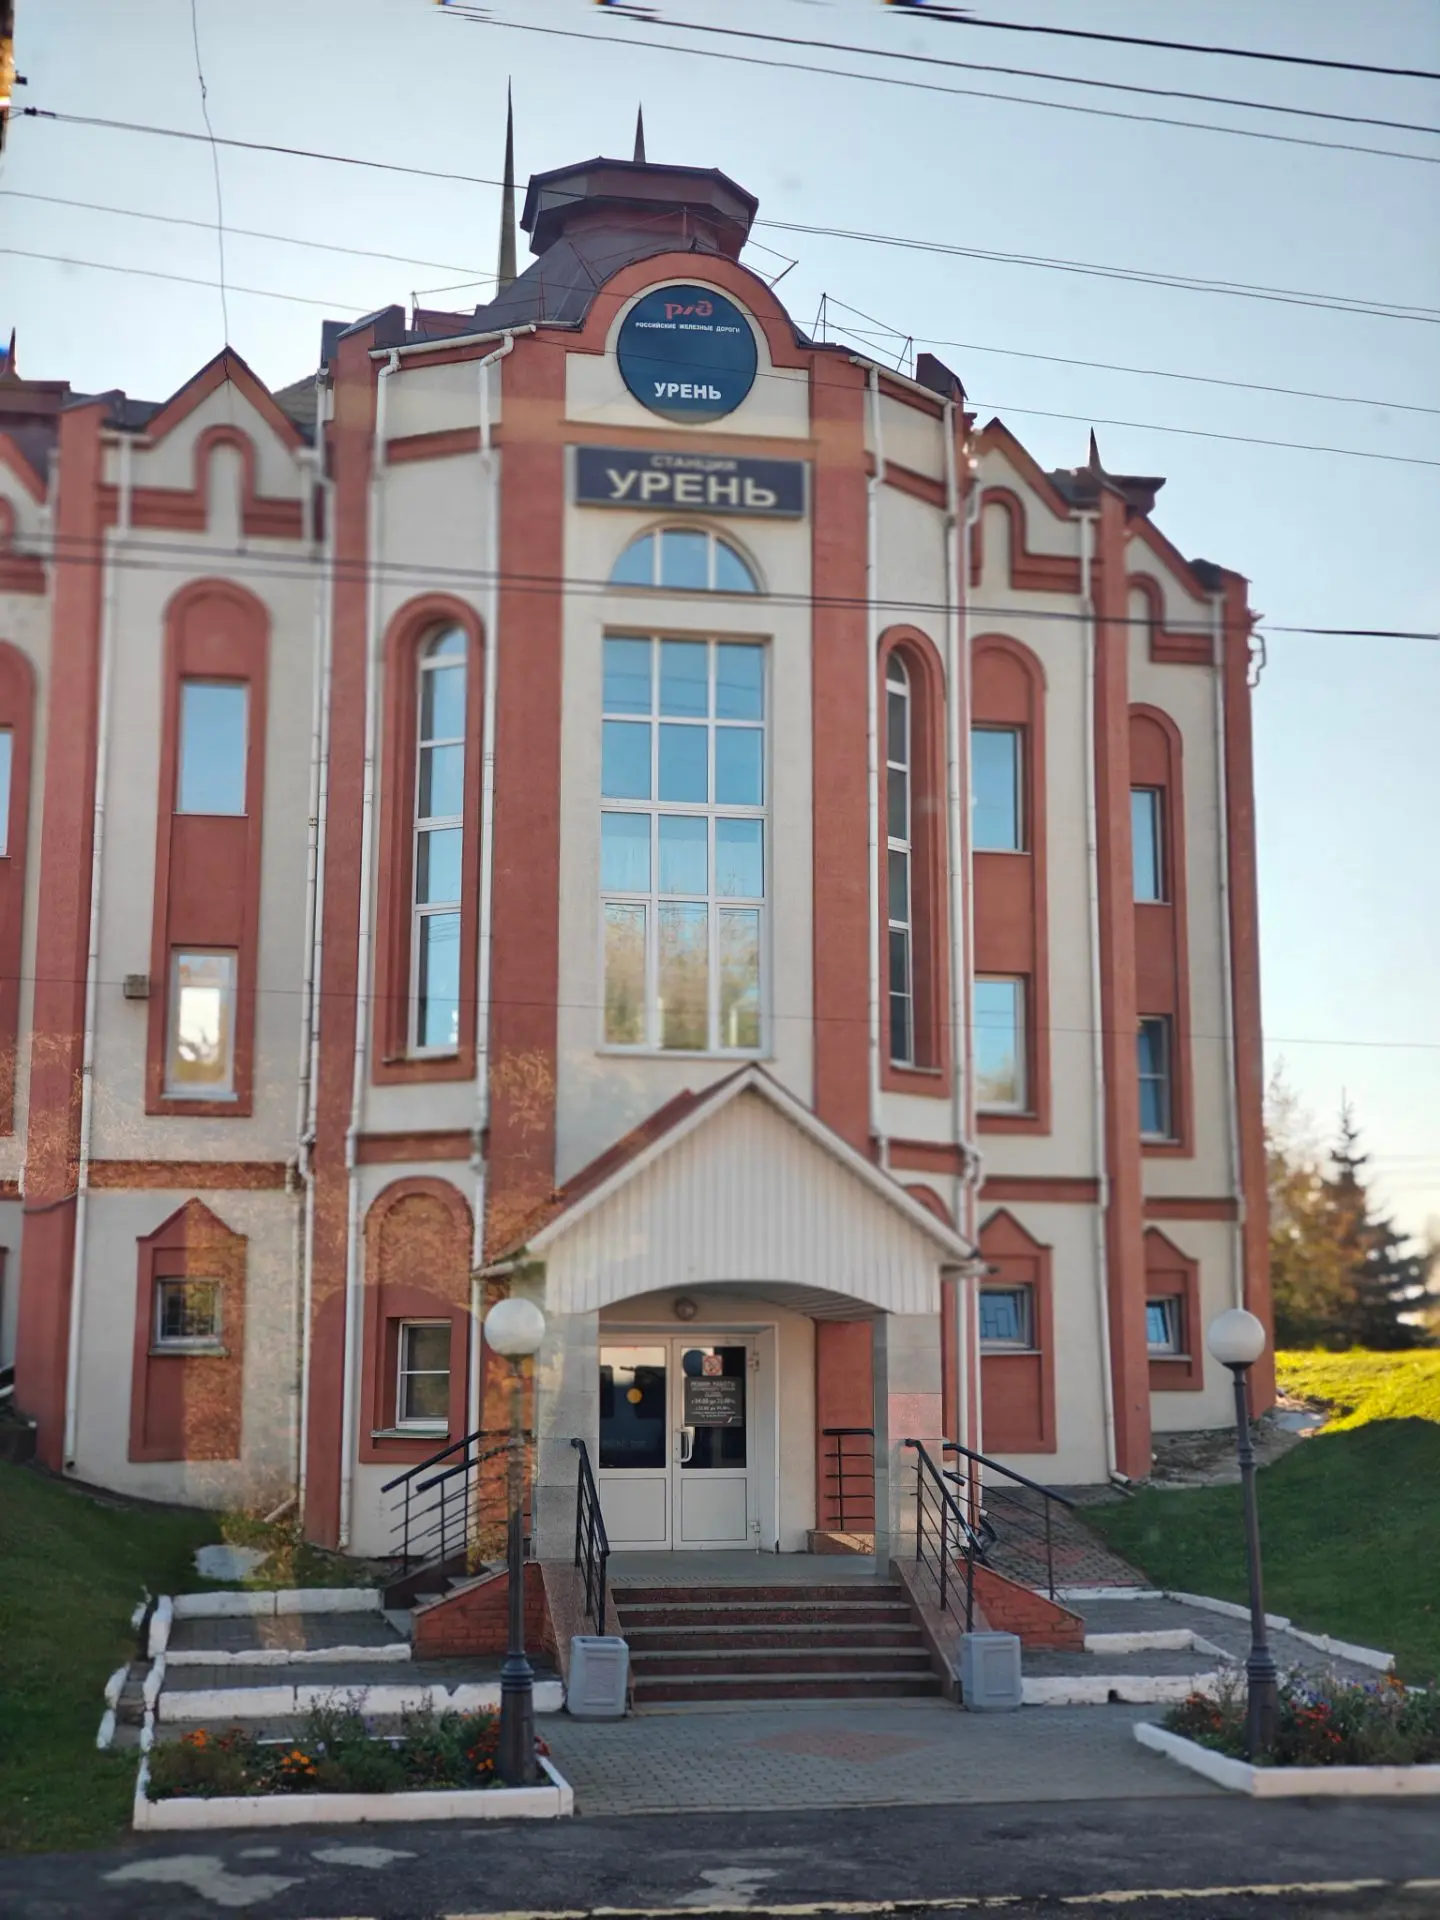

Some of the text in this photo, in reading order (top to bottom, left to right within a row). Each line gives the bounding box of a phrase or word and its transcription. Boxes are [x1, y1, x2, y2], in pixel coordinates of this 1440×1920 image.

[635, 322, 740, 333] РОССИЙСКИЕ ЖЕЛЕЗНЫЕ ДОРОГИ
[654, 382, 722, 400] УРЕНЬ
[650, 455, 738, 472] СТАНЦИЯ
[606, 469, 778, 507] УРЕНЬ
